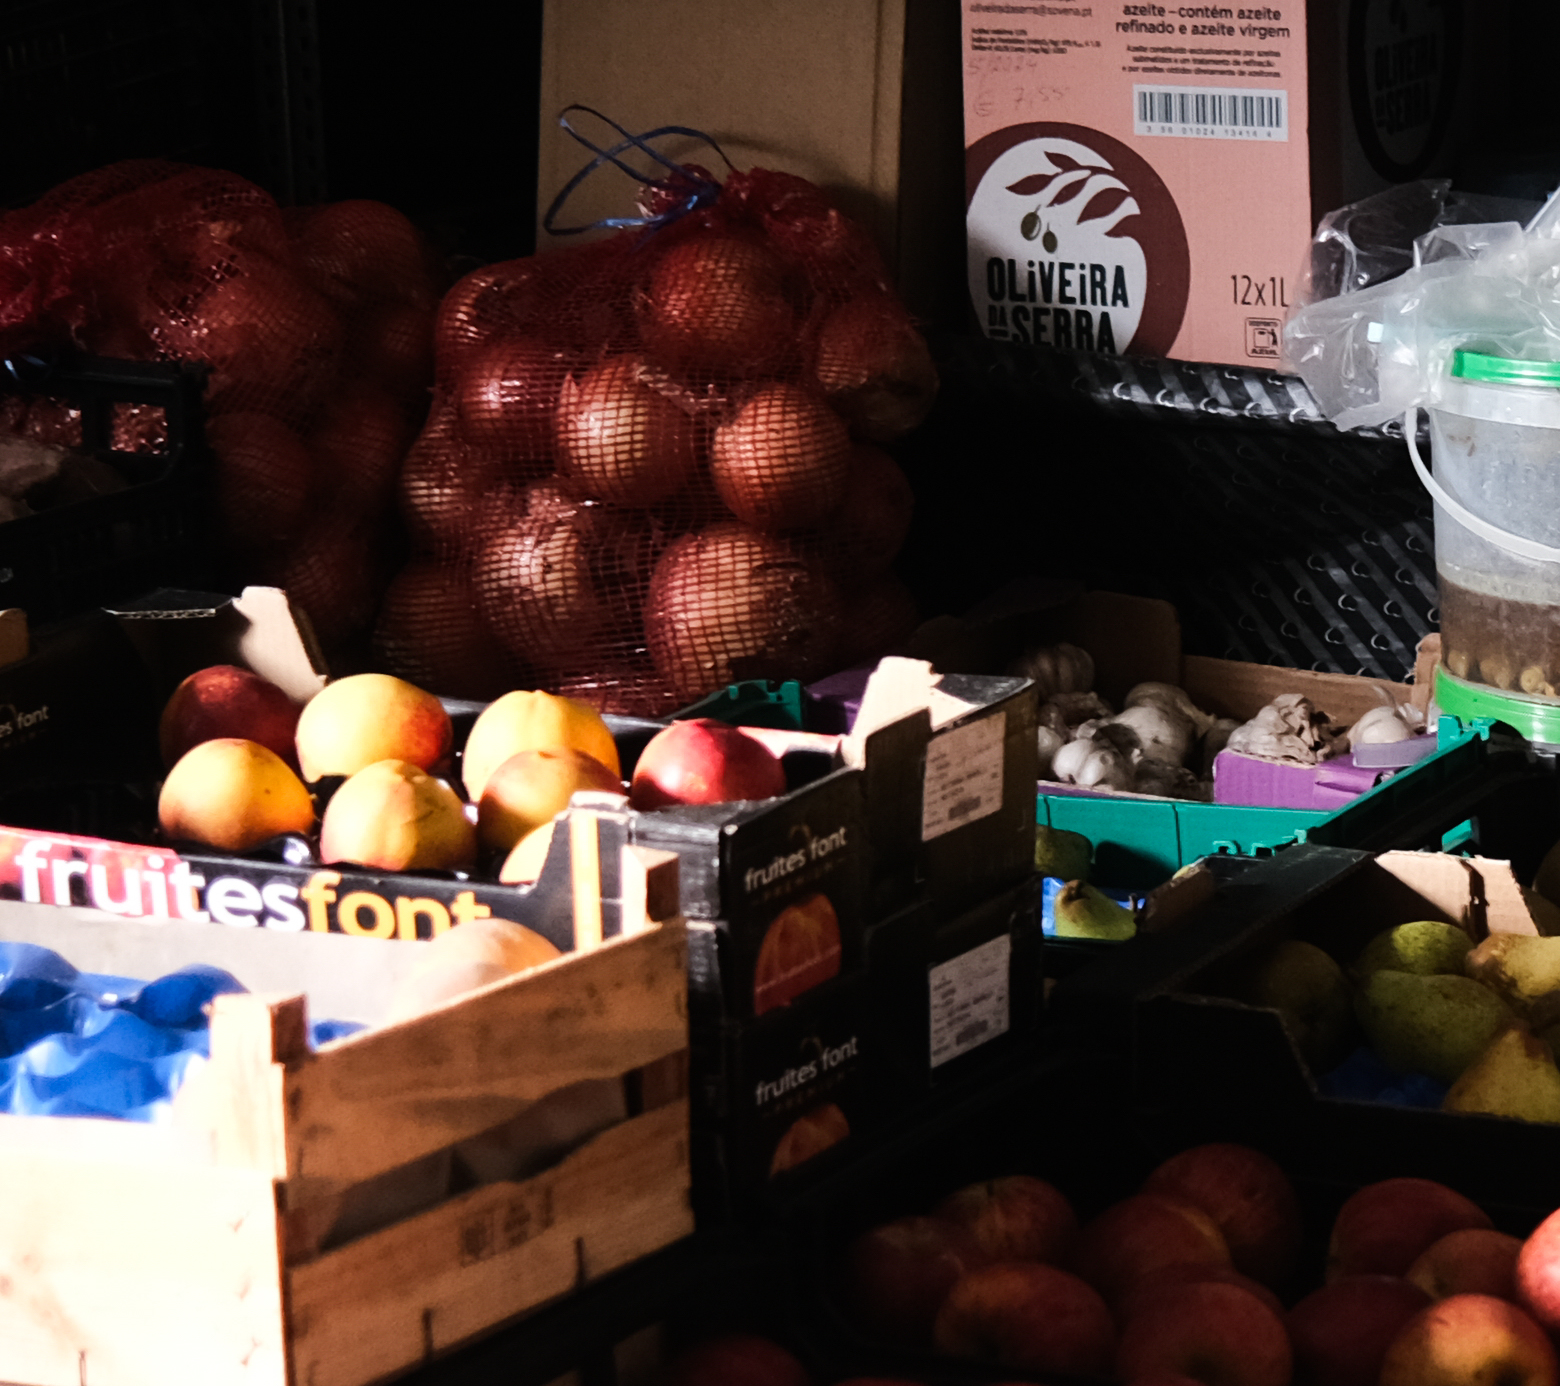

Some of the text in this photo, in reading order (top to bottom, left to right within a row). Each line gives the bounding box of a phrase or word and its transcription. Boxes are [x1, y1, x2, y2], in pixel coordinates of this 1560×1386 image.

[1116, 20, 1290, 40] refinado e azeite virgem
[1122, 4, 1282, 21] azeite contém azeite
[1231, 274, 1290, 308] 12x1L
[988, 307, 1118, 355] DA SERRA
[745, 826, 848, 893] fruites font
[755, 1035, 859, 1107] fruites font
